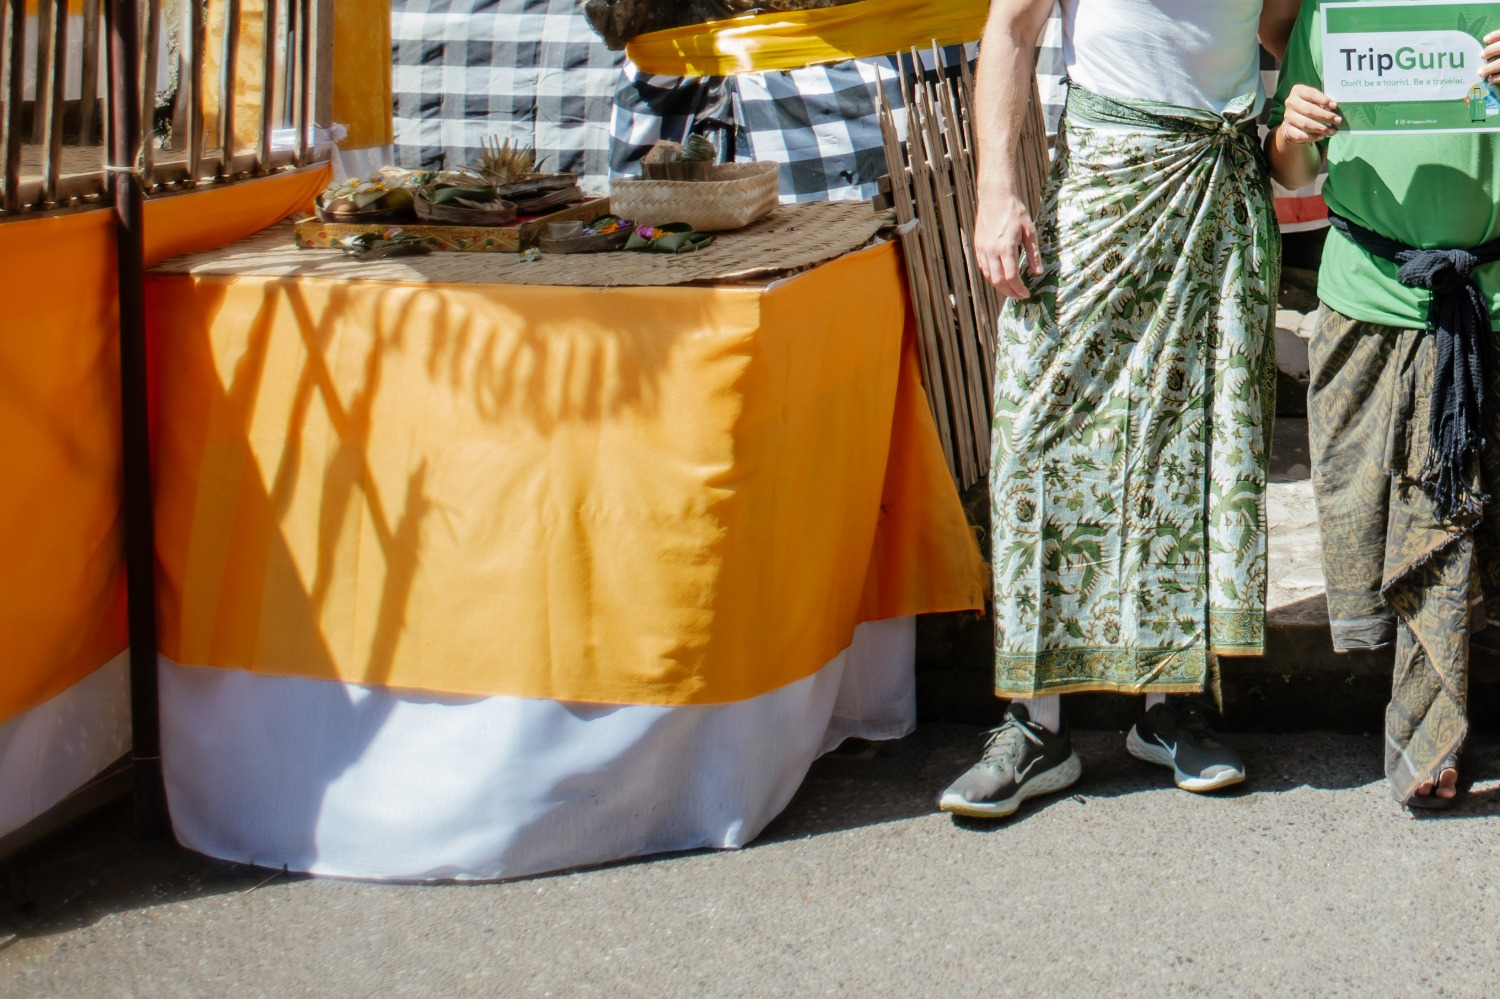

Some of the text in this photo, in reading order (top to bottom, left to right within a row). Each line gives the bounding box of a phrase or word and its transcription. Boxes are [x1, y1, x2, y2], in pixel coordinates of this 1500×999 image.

[1339, 46, 1465, 77] TripGuru
[1341, 79, 1362, 87] Don't
[1364, 79, 1375, 87] be
[1383, 78, 1412, 86] tourist.
[1413, 78, 1424, 86] Be
[1433, 77, 1465, 85] traveler.
